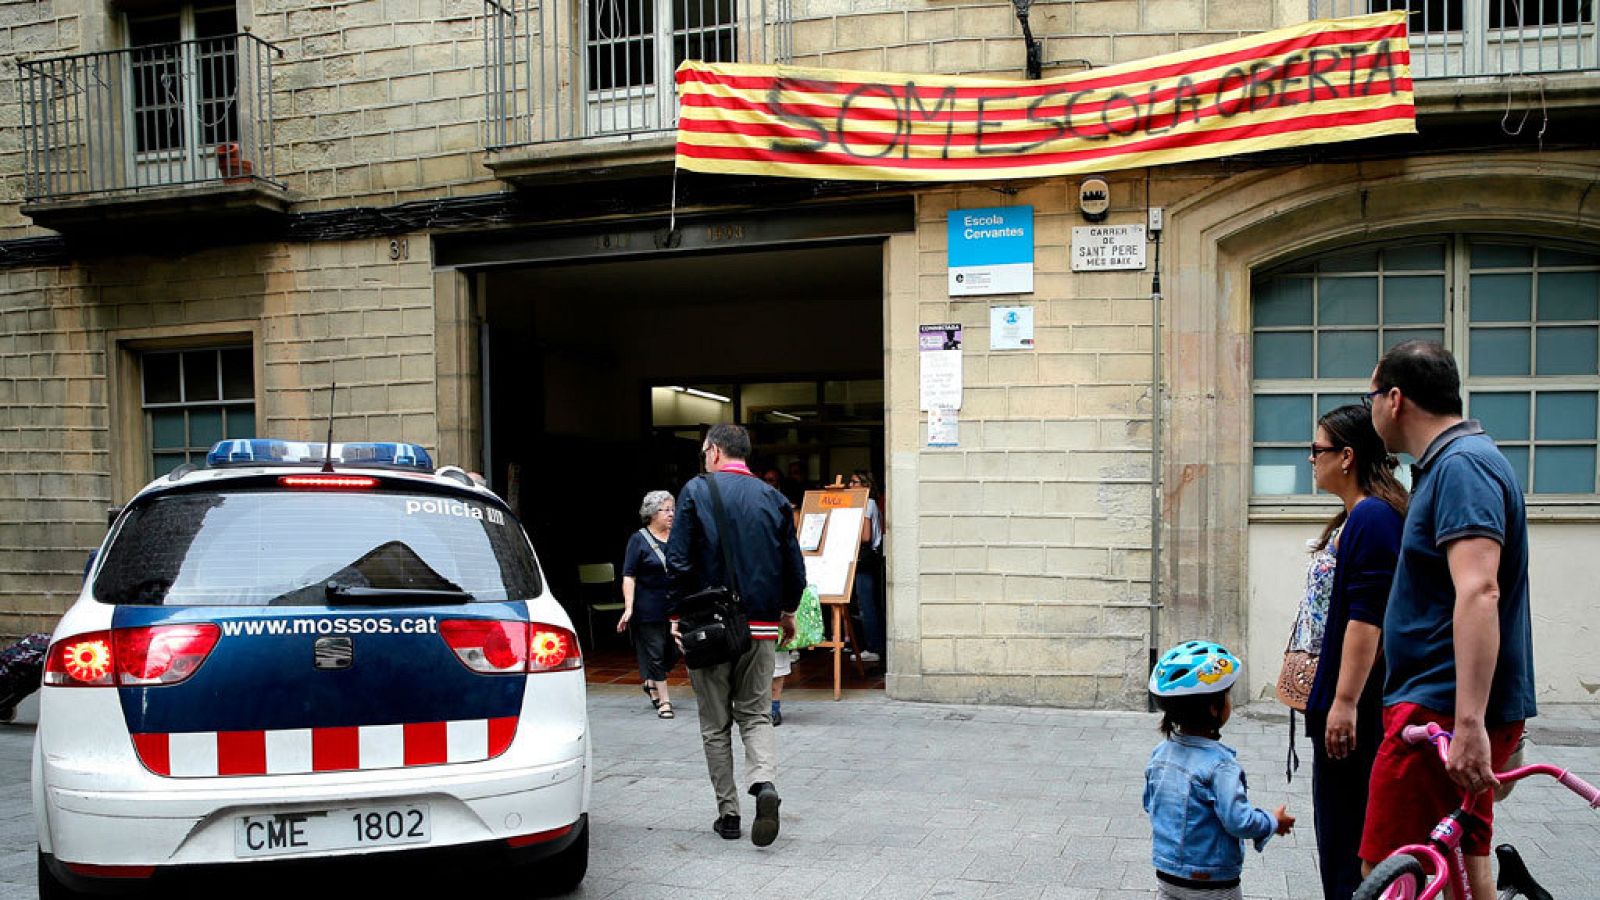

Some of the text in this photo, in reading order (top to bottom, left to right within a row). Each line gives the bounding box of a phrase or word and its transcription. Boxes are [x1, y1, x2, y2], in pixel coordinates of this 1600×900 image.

[769, 38, 1399, 160] SOM ESCOLA OBERTA
[964, 214, 1004, 227] Escola
[964, 227, 1024, 240] Cervantes
[1090, 228, 1128, 237] CARRER
[1102, 237, 1115, 245] DE
[390, 238, 408, 260] 31
[1079, 244, 1139, 257] SANT PERE
[221, 616, 437, 636] www.mossos.cat
[246, 809, 424, 850] CME 1802
